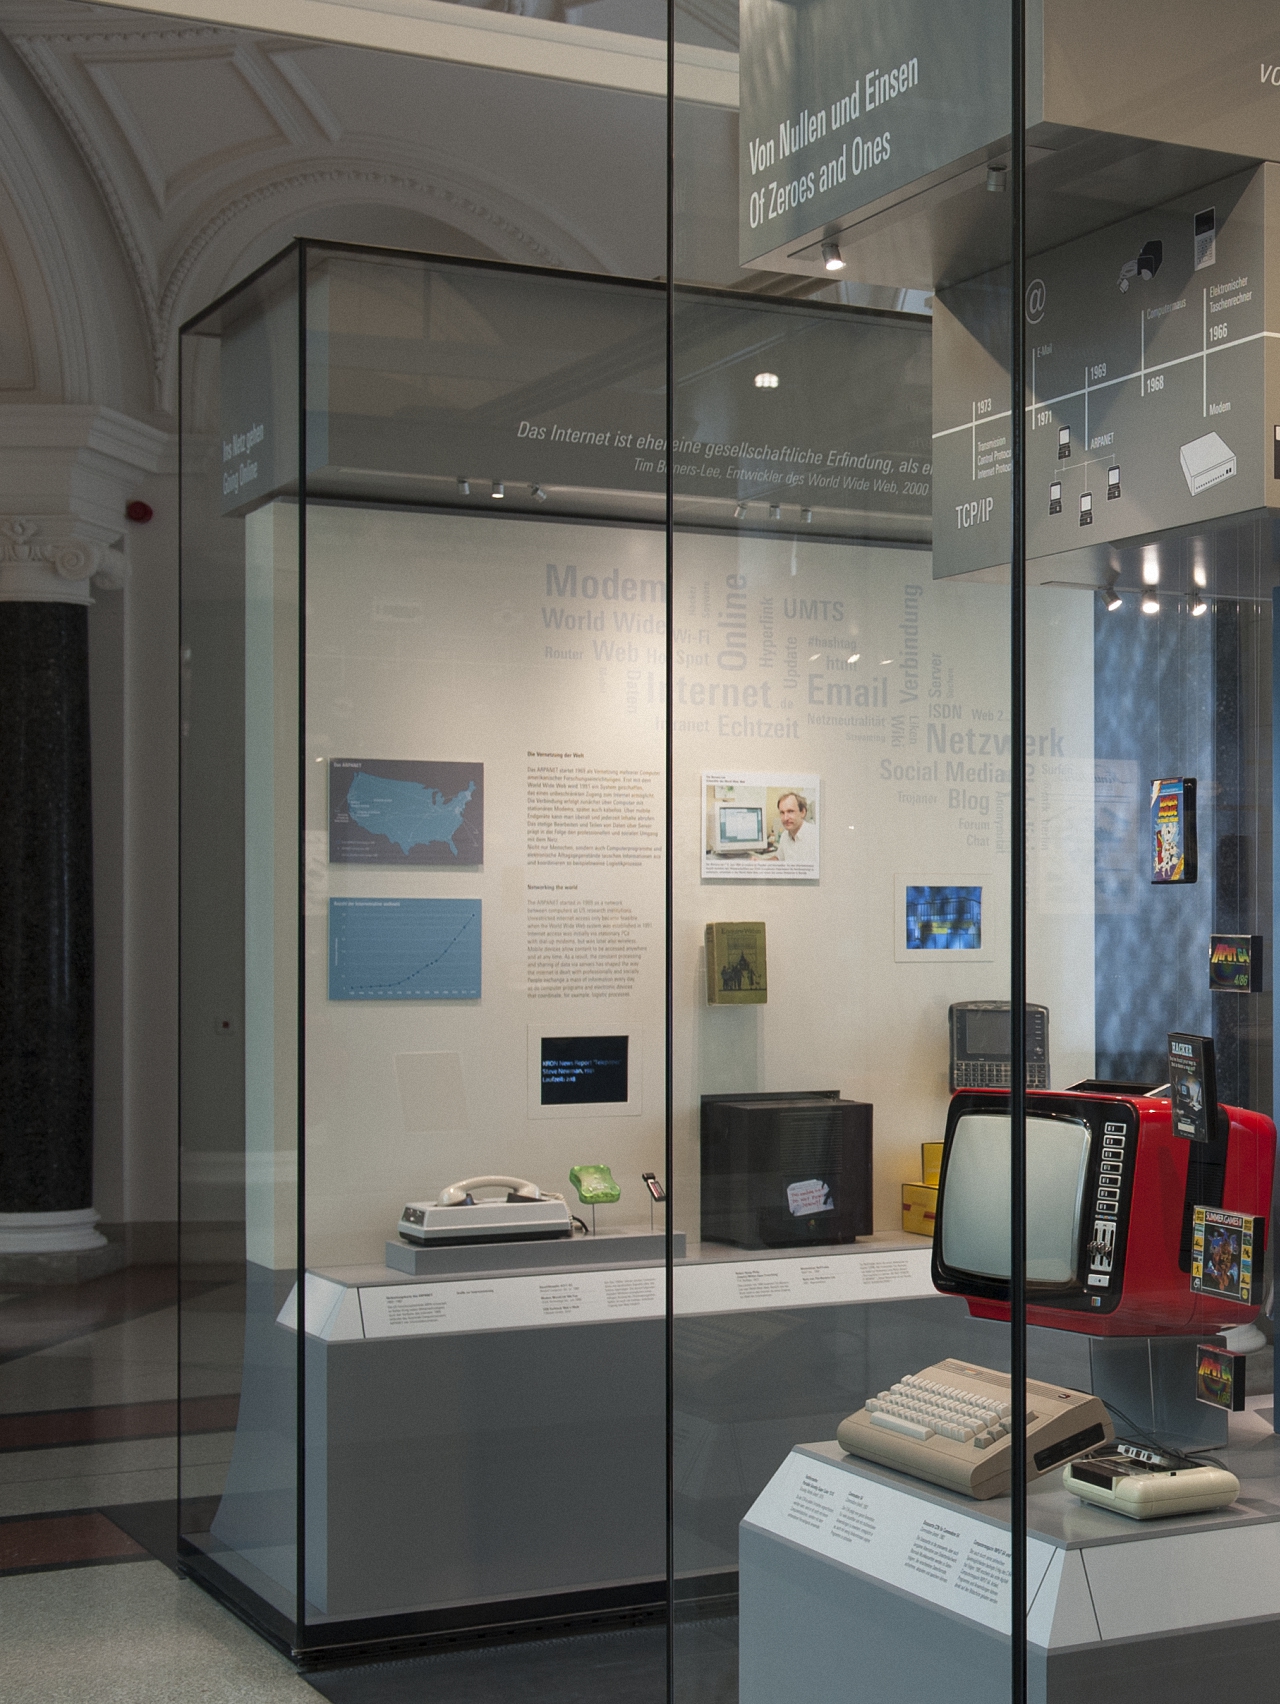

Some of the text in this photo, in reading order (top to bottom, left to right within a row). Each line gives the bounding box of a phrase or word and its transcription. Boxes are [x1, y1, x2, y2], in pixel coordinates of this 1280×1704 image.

[750, 58, 918, 175] Von Nullen und Einsen
[750, 132, 890, 228] Of Zeroes and Ones
[1210, 276, 1248, 298] Elektronischer
[1147, 298, 1186, 320] Computermaus
[1210, 290, 1252, 313] Taschenrechner
[1210, 323, 1228, 342] 1966
[1038, 343, 1052, 358] E-Mail
[1090, 362, 1106, 380] 1969
[1146, 375, 1164, 394] 1968
[978, 398, 992, 414] 1973
[1210, 400, 1231, 416] Modem
[1038, 410, 1052, 426] 1971
[517, 421, 546, 440] Das
[550, 424, 611, 446] Internet
[614, 431, 632, 448] ist
[672, 436, 702, 454] eine
[704, 442, 822, 464] gesellschaftliche
[827, 450, 894, 474] Erfindung,
[899, 458, 918, 474] als
[1090, 432, 1114, 450] ARPANET
[634, 458, 654, 472] Tim
[726, 466, 782, 483] Entwickler
[786, 472, 804, 485] des
[808, 474, 840, 488] World
[843, 477, 870, 490] Wide
[874, 479, 899, 494] Web,
[902, 482, 929, 496] 2000
[956, 496, 994, 529] TCP/IP
[546, 564, 666, 604] Modem
[784, 598, 844, 621] UMTS
[541, 607, 666, 636] World Wide
[717, 573, 746, 671] Online
[760, 596, 776, 668] Hyperlink
[592, 640, 639, 662] Web
[900, 584, 922, 704] Verbindung
[928, 652, 942, 698] Server
[808, 674, 888, 708] Email
[928, 704, 962, 720] ISDN
[718, 714, 799, 738] Echtzeit
[880, 758, 938, 782] Social
[949, 789, 990, 815] Blog
[1234, 974, 1248, 986] 4/86
[1172, 1042, 1192, 1056] HACKER
